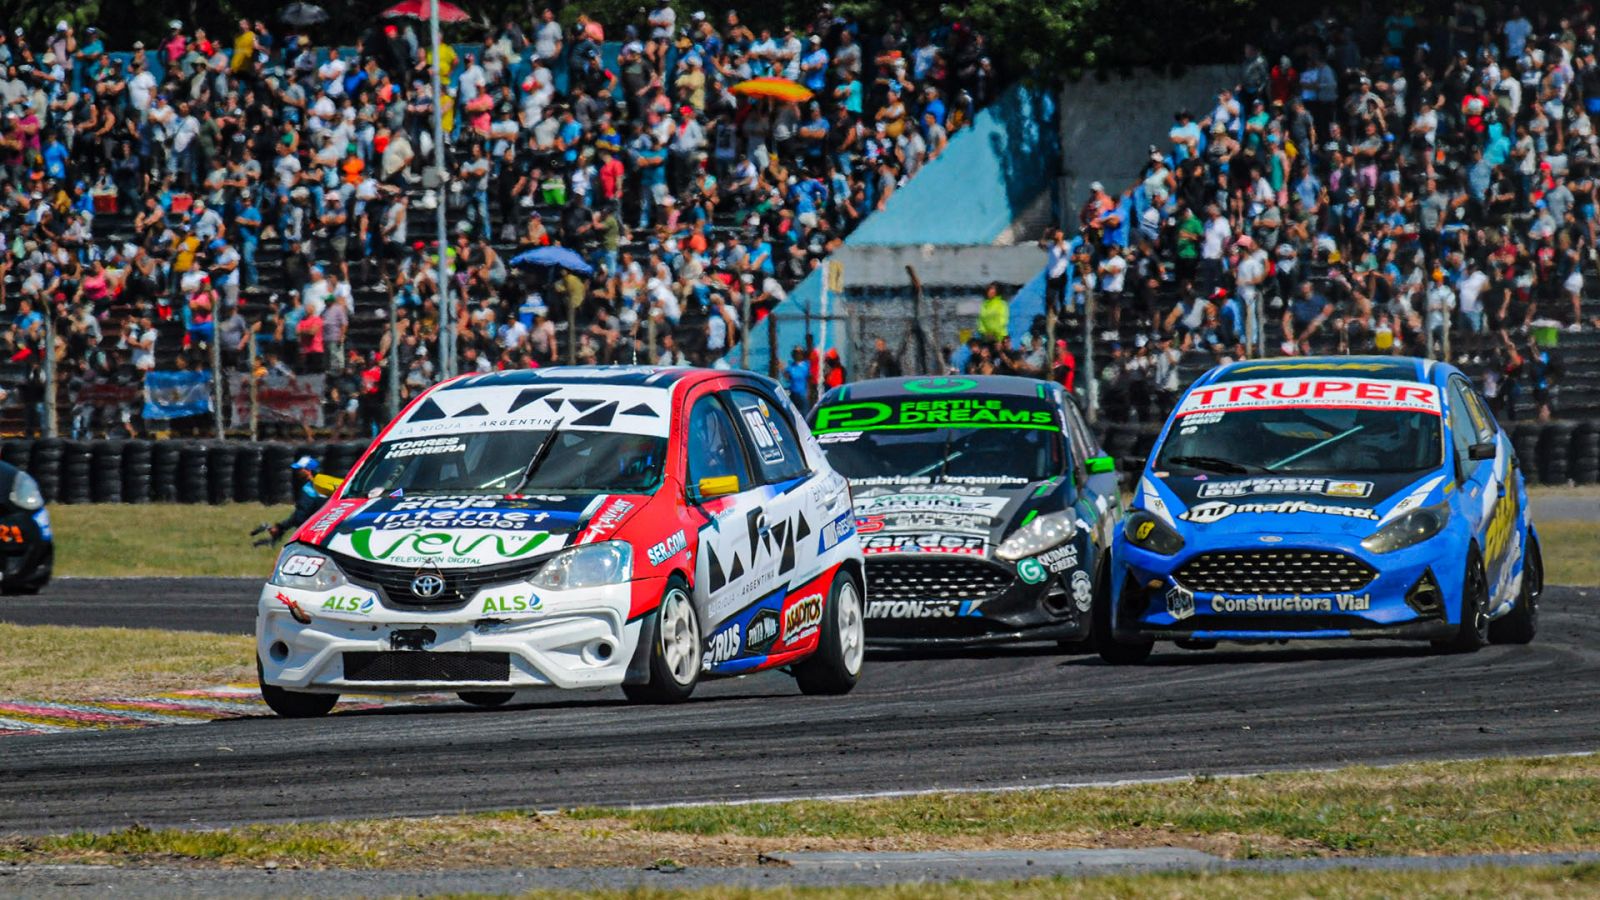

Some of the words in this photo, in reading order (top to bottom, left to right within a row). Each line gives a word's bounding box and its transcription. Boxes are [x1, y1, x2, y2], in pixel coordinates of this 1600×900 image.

[1191, 382, 1434, 405] TRUPER
[900, 400, 1001, 411] FERTILE
[900, 409, 1052, 424] DREAMS
[385, 443, 466, 459] HERRERA
[390, 437, 459, 451] TORRES
[391, 499, 497, 511] Rioja
[282, 555, 326, 577] 66
[447, 557, 481, 565] DIGITAL
[322, 596, 361, 611] ALS
[482, 595, 527, 613] ALS
[1211, 594, 1332, 613] Constructora
[1336, 593, 1370, 611] Vial
